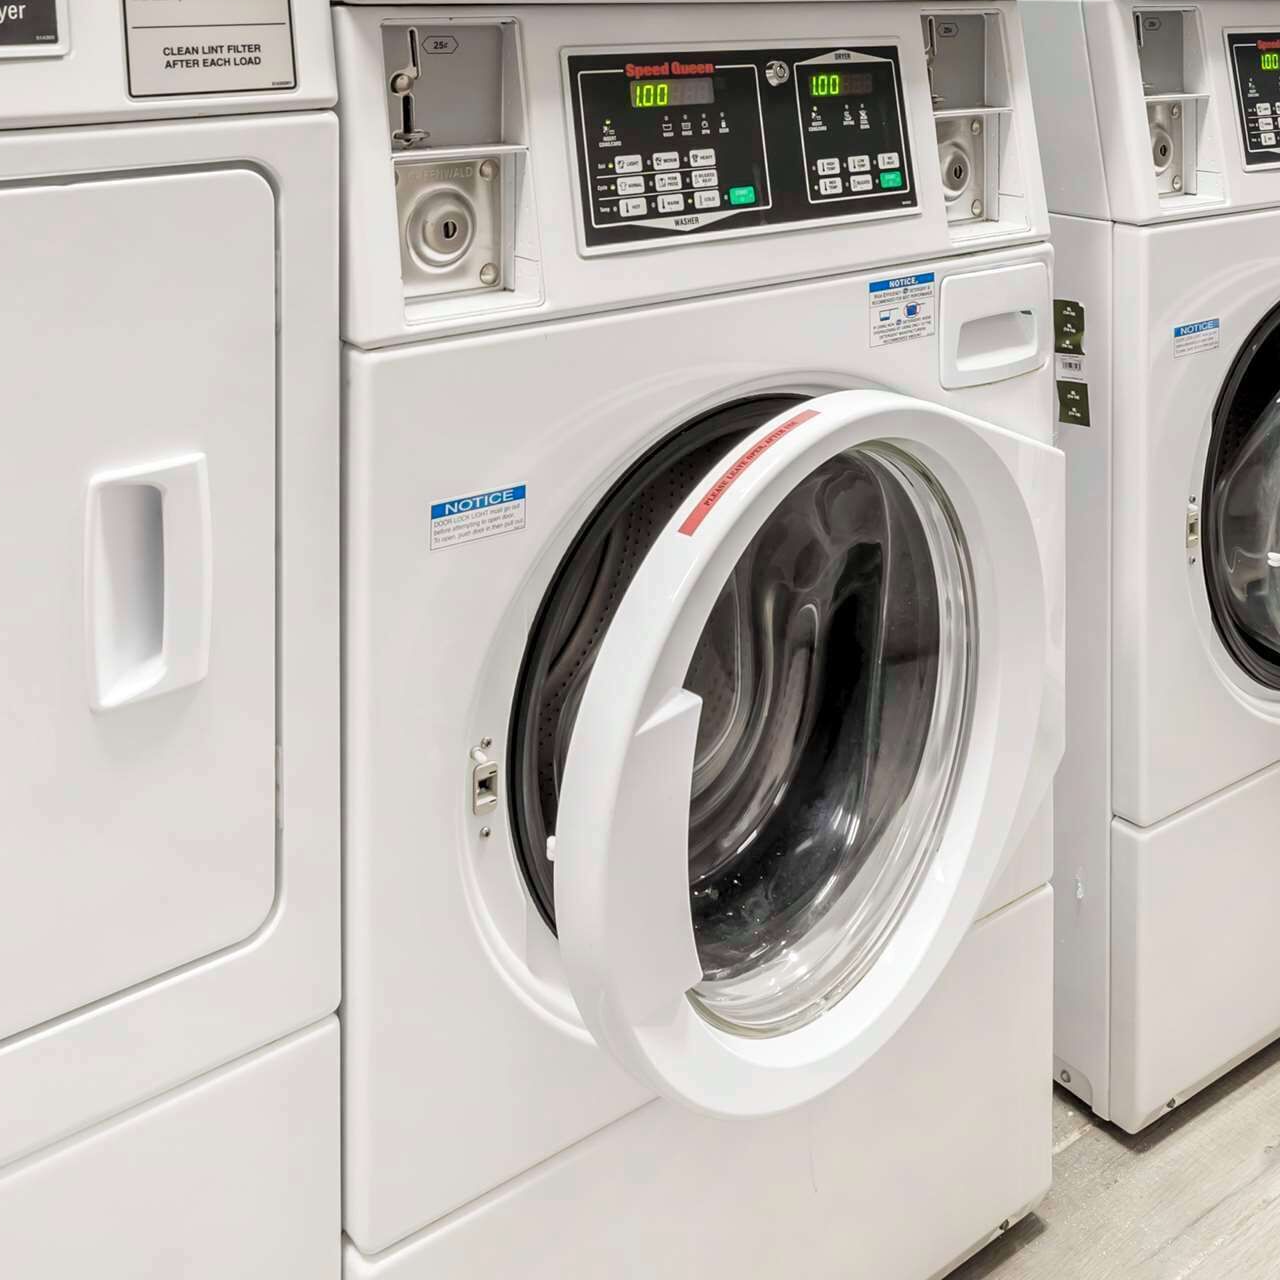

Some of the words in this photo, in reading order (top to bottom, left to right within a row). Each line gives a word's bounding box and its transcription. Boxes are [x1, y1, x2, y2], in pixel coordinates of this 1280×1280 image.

[162, 46, 199, 56] CLEAN
[201, 45, 224, 55] LINT
[227, 44, 262, 54] FILTER
[164, 59, 199, 70] AFTER
[202, 58, 230, 68] EACH
[233, 56, 262, 66] LOAD
[625, 61, 670, 79] Speed
[670, 61, 714, 75] Queen
[811, 75, 840, 96] 1.00
[636, 84, 669, 107] 1.00
[673, 216, 700, 228] WASHER
[1181, 320, 1215, 334] NOTICE
[703, 480, 728, 506] PLEASE
[726, 460, 748, 481] LEAVE
[445, 490, 514, 515] NOTICE
